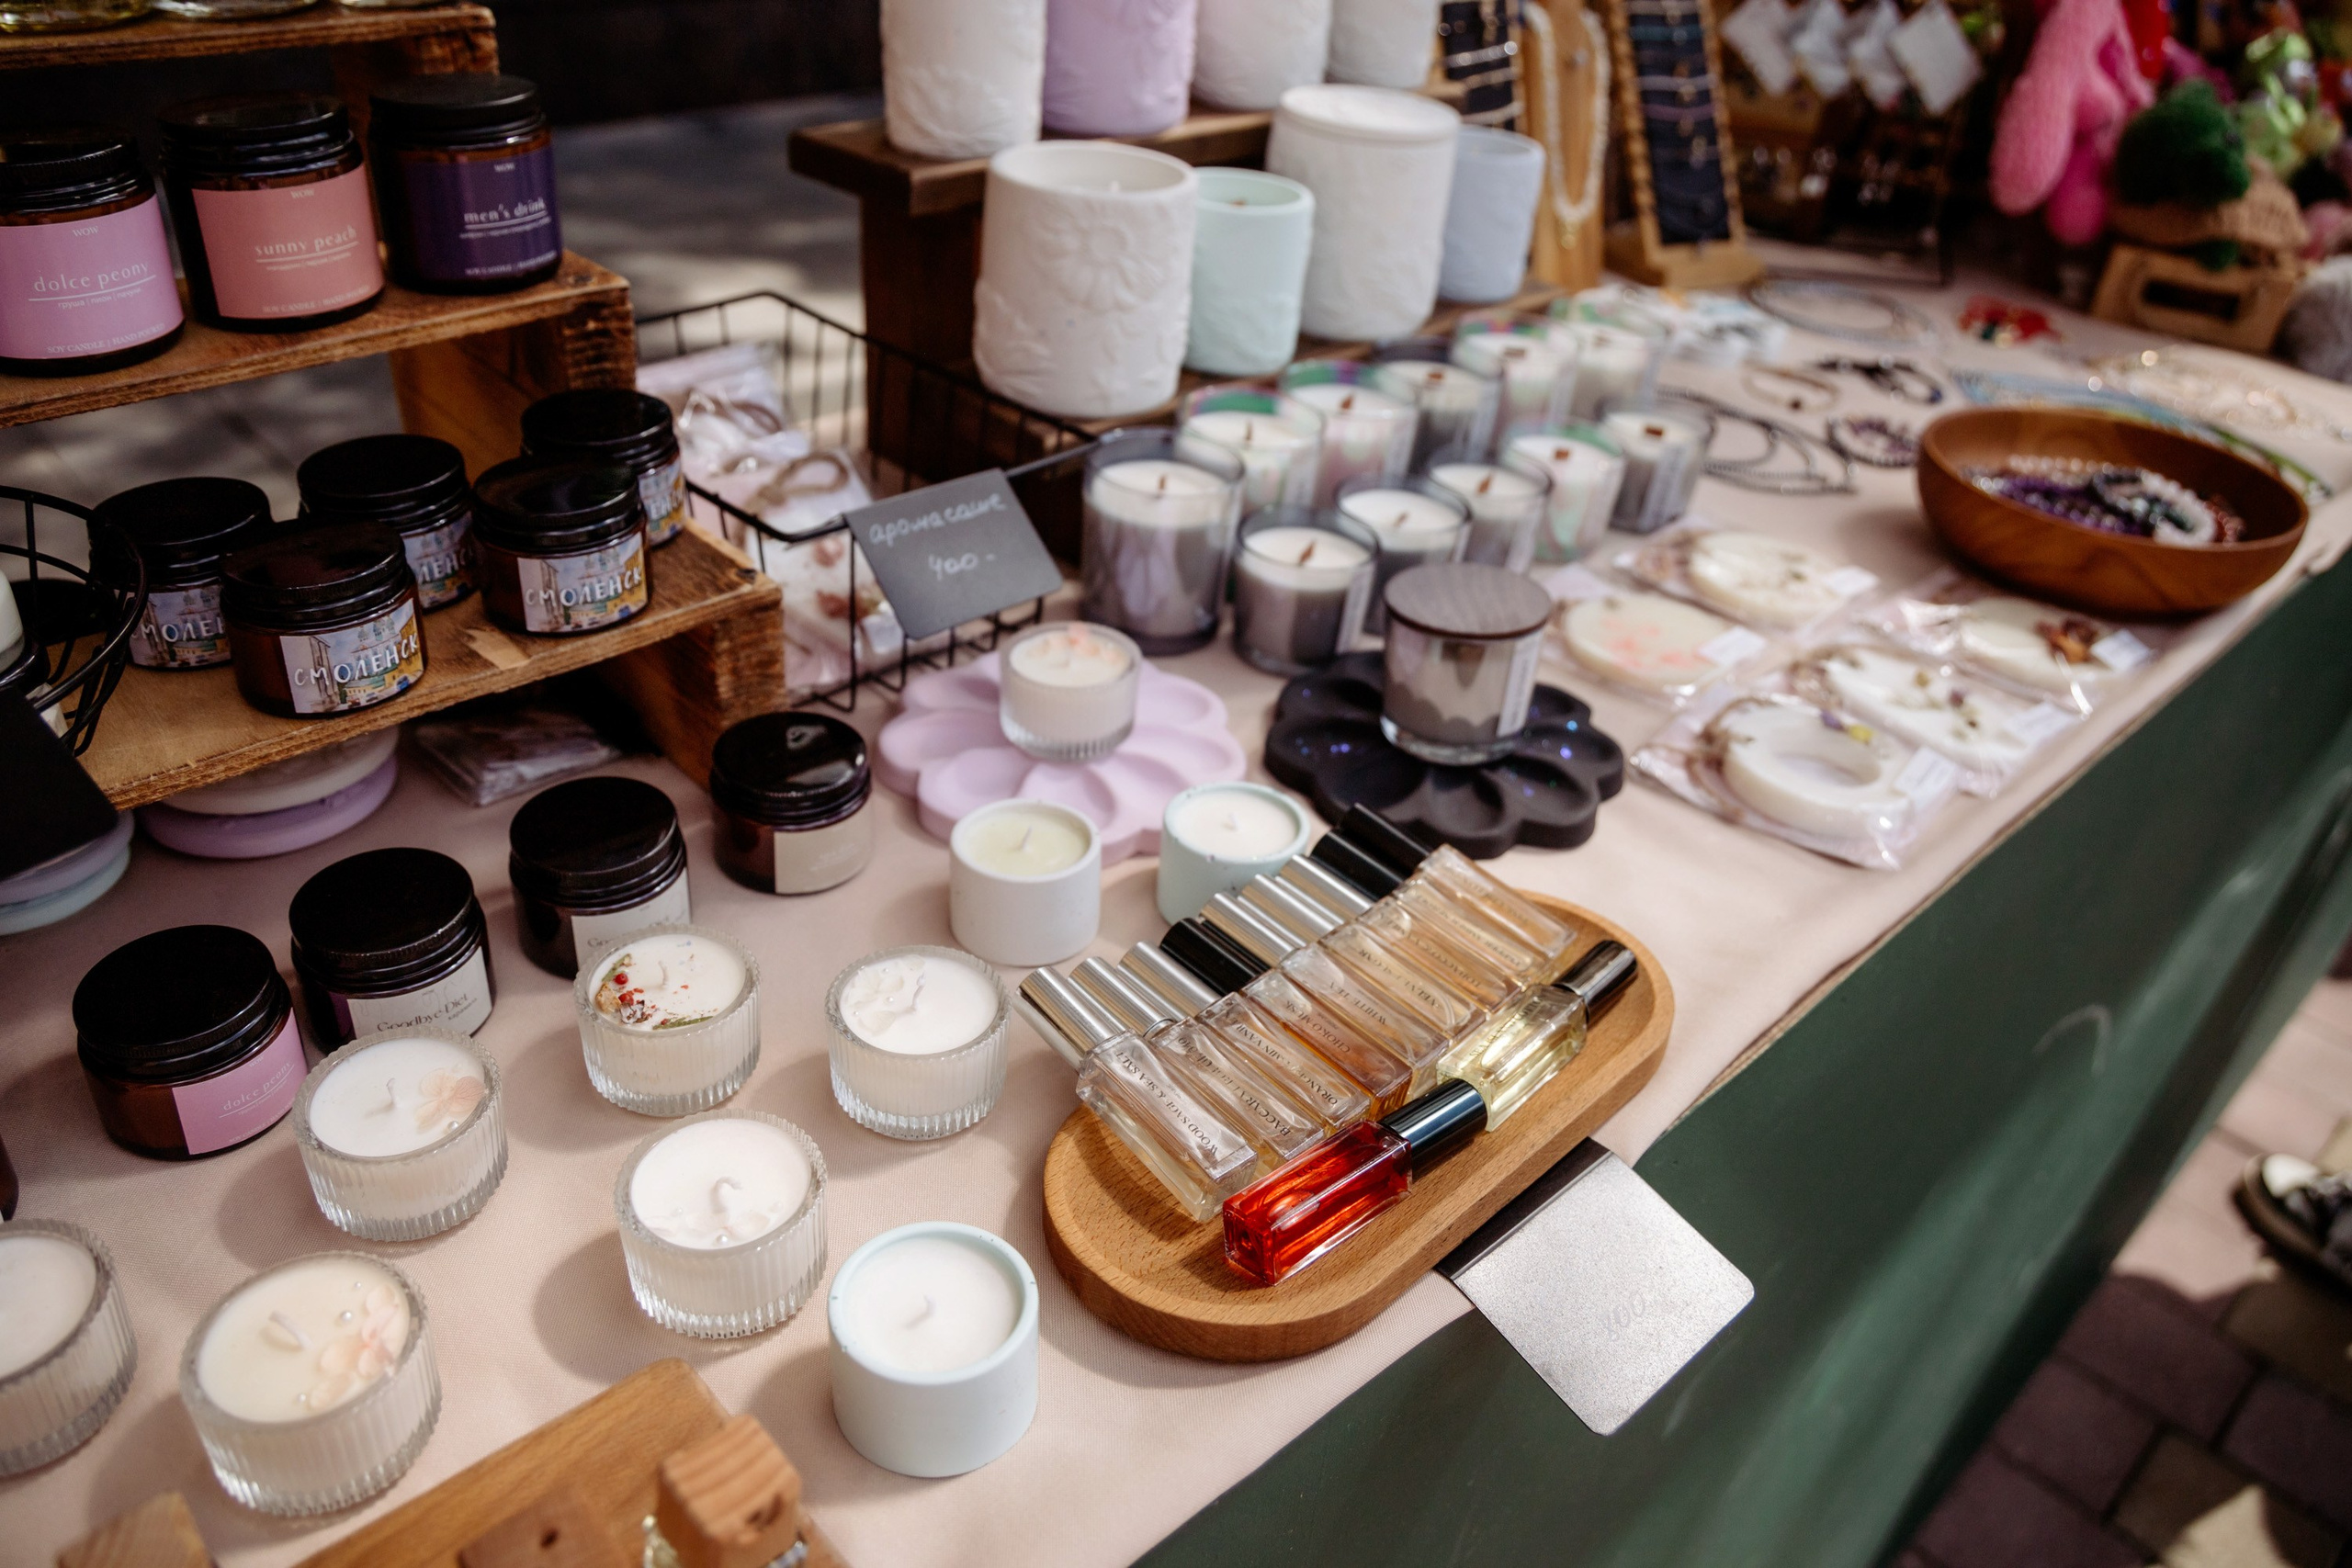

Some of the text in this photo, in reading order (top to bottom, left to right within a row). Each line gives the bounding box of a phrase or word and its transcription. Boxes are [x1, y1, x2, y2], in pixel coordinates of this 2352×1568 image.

[514, 197, 547, 217] drink
[73, 225, 99, 238] WOW
[254, 224, 357, 256] sunny peach
[34, 263, 149, 292] dolce peony
[47, 344, 66, 355] SOY
[67, 340, 106, 353] CANDLE
[112, 332, 136, 345] HAND
[525, 567, 642, 607] СМОЛЕНСК
[294, 632, 418, 686] СМОЛЕНСК
[1329, 979, 1351, 999] TEA
[445, 994, 468, 1014] Diet
[1352, 997, 1386, 1024] WHITE
[1283, 998, 1351, 1054] CHOKO MUSK
[1114, 1050, 1140, 1076] SALT
[1137, 1072, 1159, 1093] SEA
[223, 1089, 262, 1111] dolce
[1163, 1099, 1191, 1125] SAGE
[1186, 1121, 1219, 1155] WOOD
